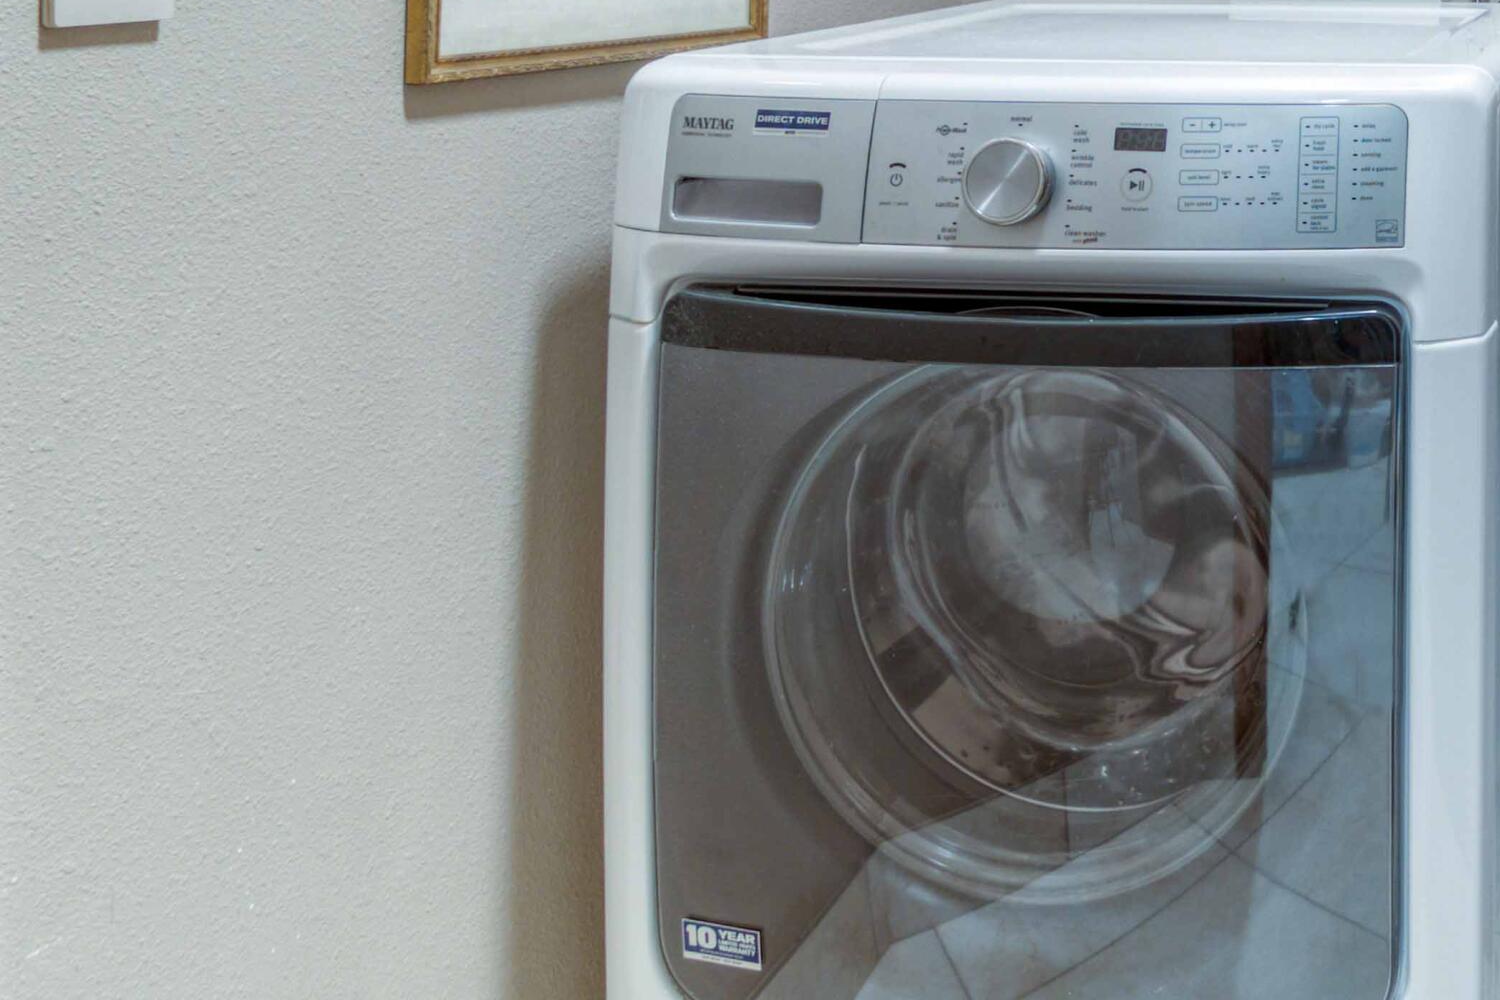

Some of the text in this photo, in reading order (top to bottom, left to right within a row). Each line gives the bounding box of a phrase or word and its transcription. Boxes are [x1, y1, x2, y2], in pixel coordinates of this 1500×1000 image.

[682, 116, 735, 131] MAYTAG
[757, 114, 829, 126] DIRECT DRIVE
[686, 924, 717, 950] 10
[718, 928, 755, 945] YEAR
